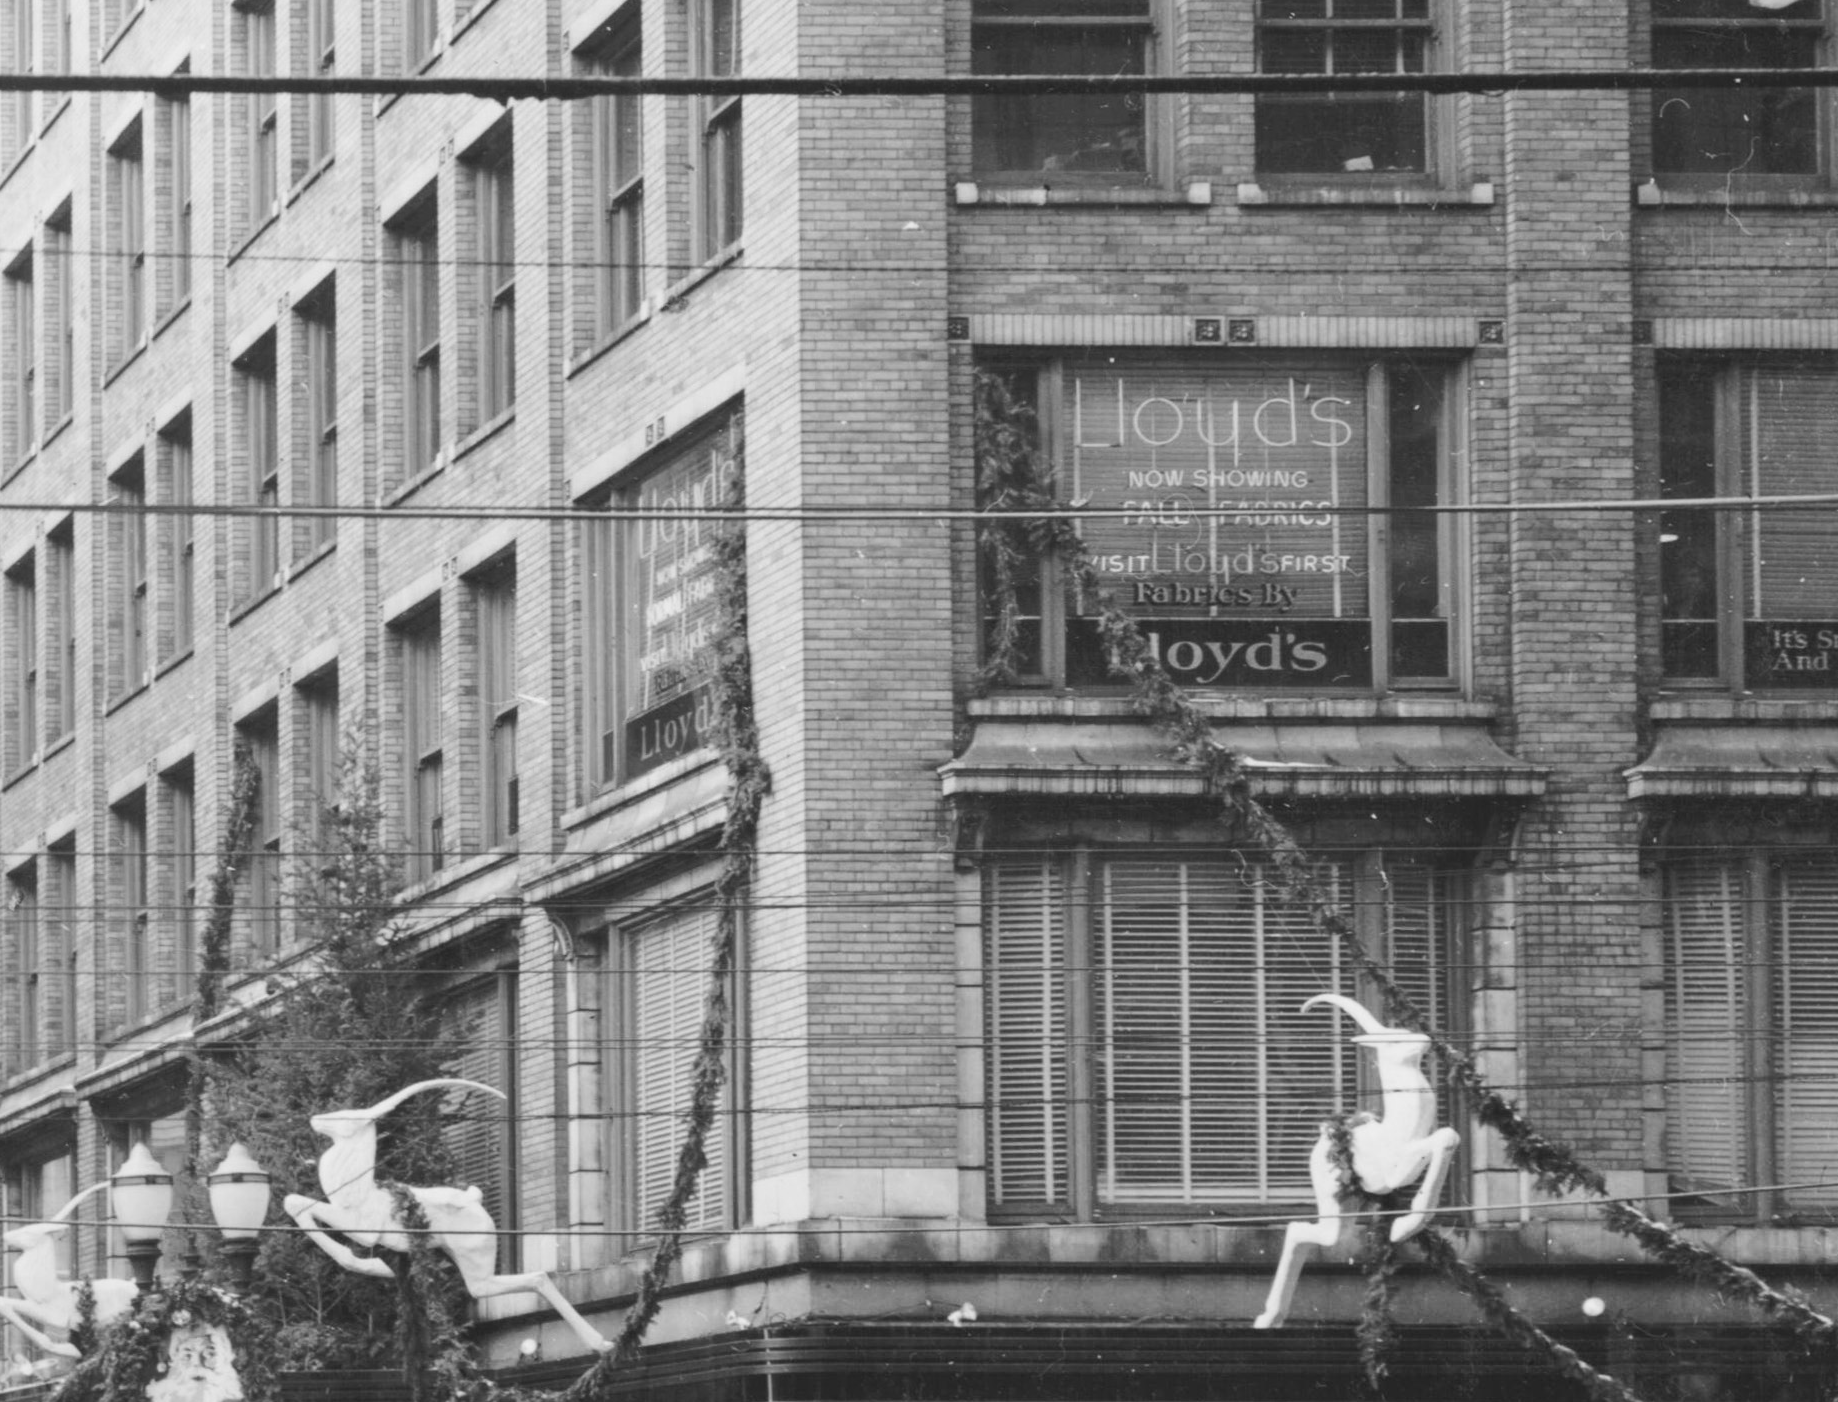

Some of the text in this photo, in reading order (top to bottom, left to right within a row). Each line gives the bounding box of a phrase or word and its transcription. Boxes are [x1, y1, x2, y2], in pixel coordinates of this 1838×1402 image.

[1073, 376, 1353, 467] Lloyd's
[1128, 469, 1309, 489] NOW SHOWING
[1124, 500, 1191, 526] FALL
[1281, 554, 1351, 573] FIRST
[1135, 582, 1300, 612] Fabrics By
[1773, 629, 1809, 649] It's
[1111, 627, 1328, 684] loyd's
[1772, 650, 1830, 672] And
